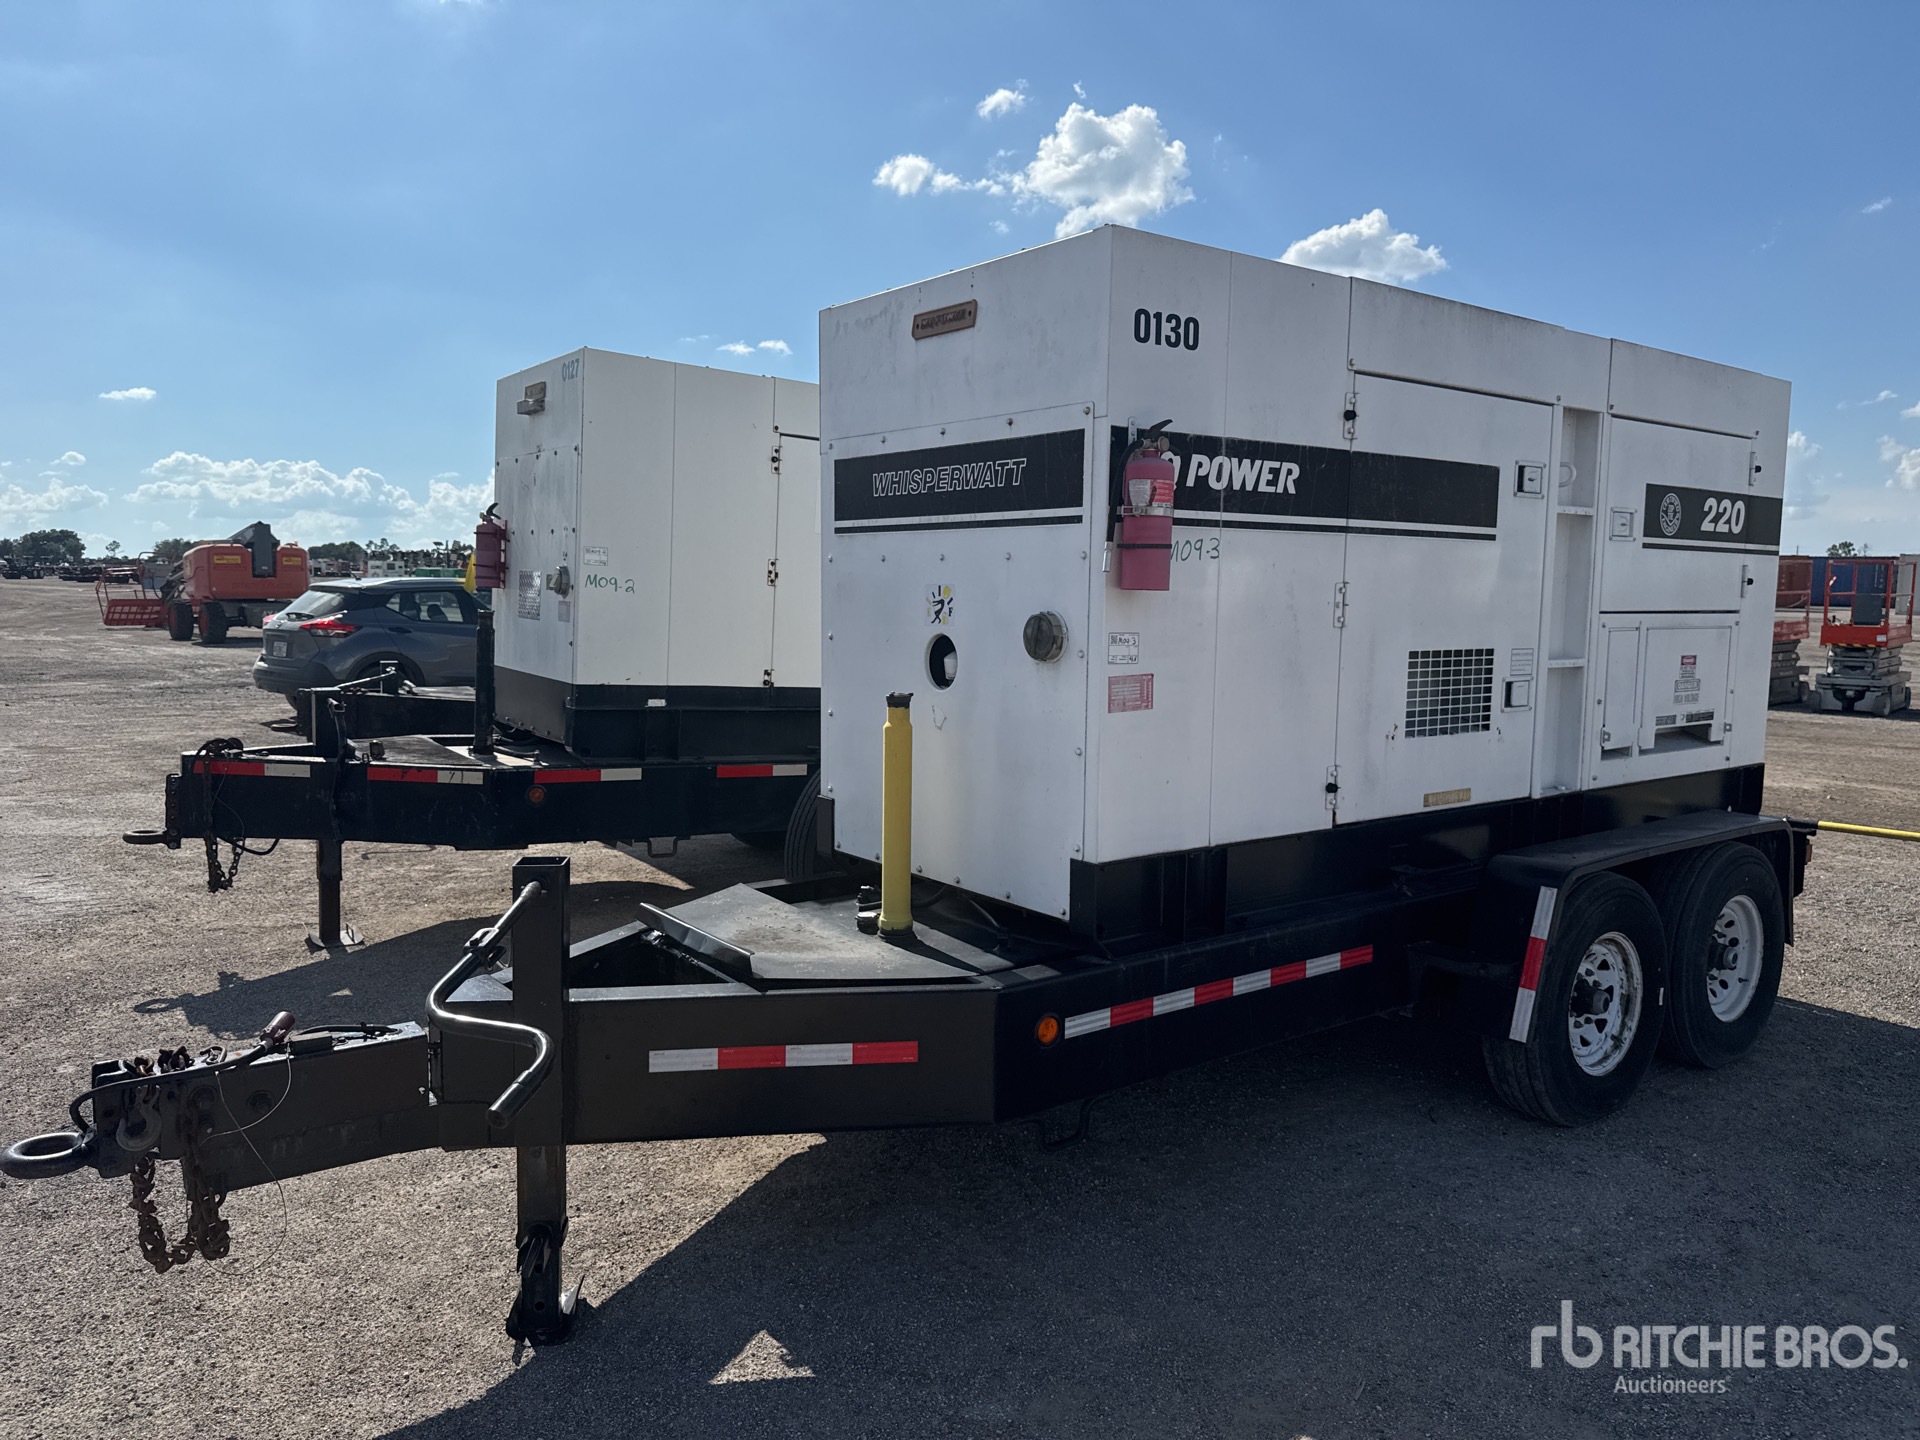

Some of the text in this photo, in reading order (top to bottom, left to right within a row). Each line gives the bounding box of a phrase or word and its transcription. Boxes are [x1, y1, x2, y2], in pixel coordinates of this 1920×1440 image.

[1133, 307, 1200, 351] 0130
[561, 358, 580, 382] 0127
[872, 457, 1027, 498] WHISPERWATT
[1185, 452, 1300, 494] POWER
[1700, 497, 1746, 535] 220
[584, 573, 635, 595] M09-2
